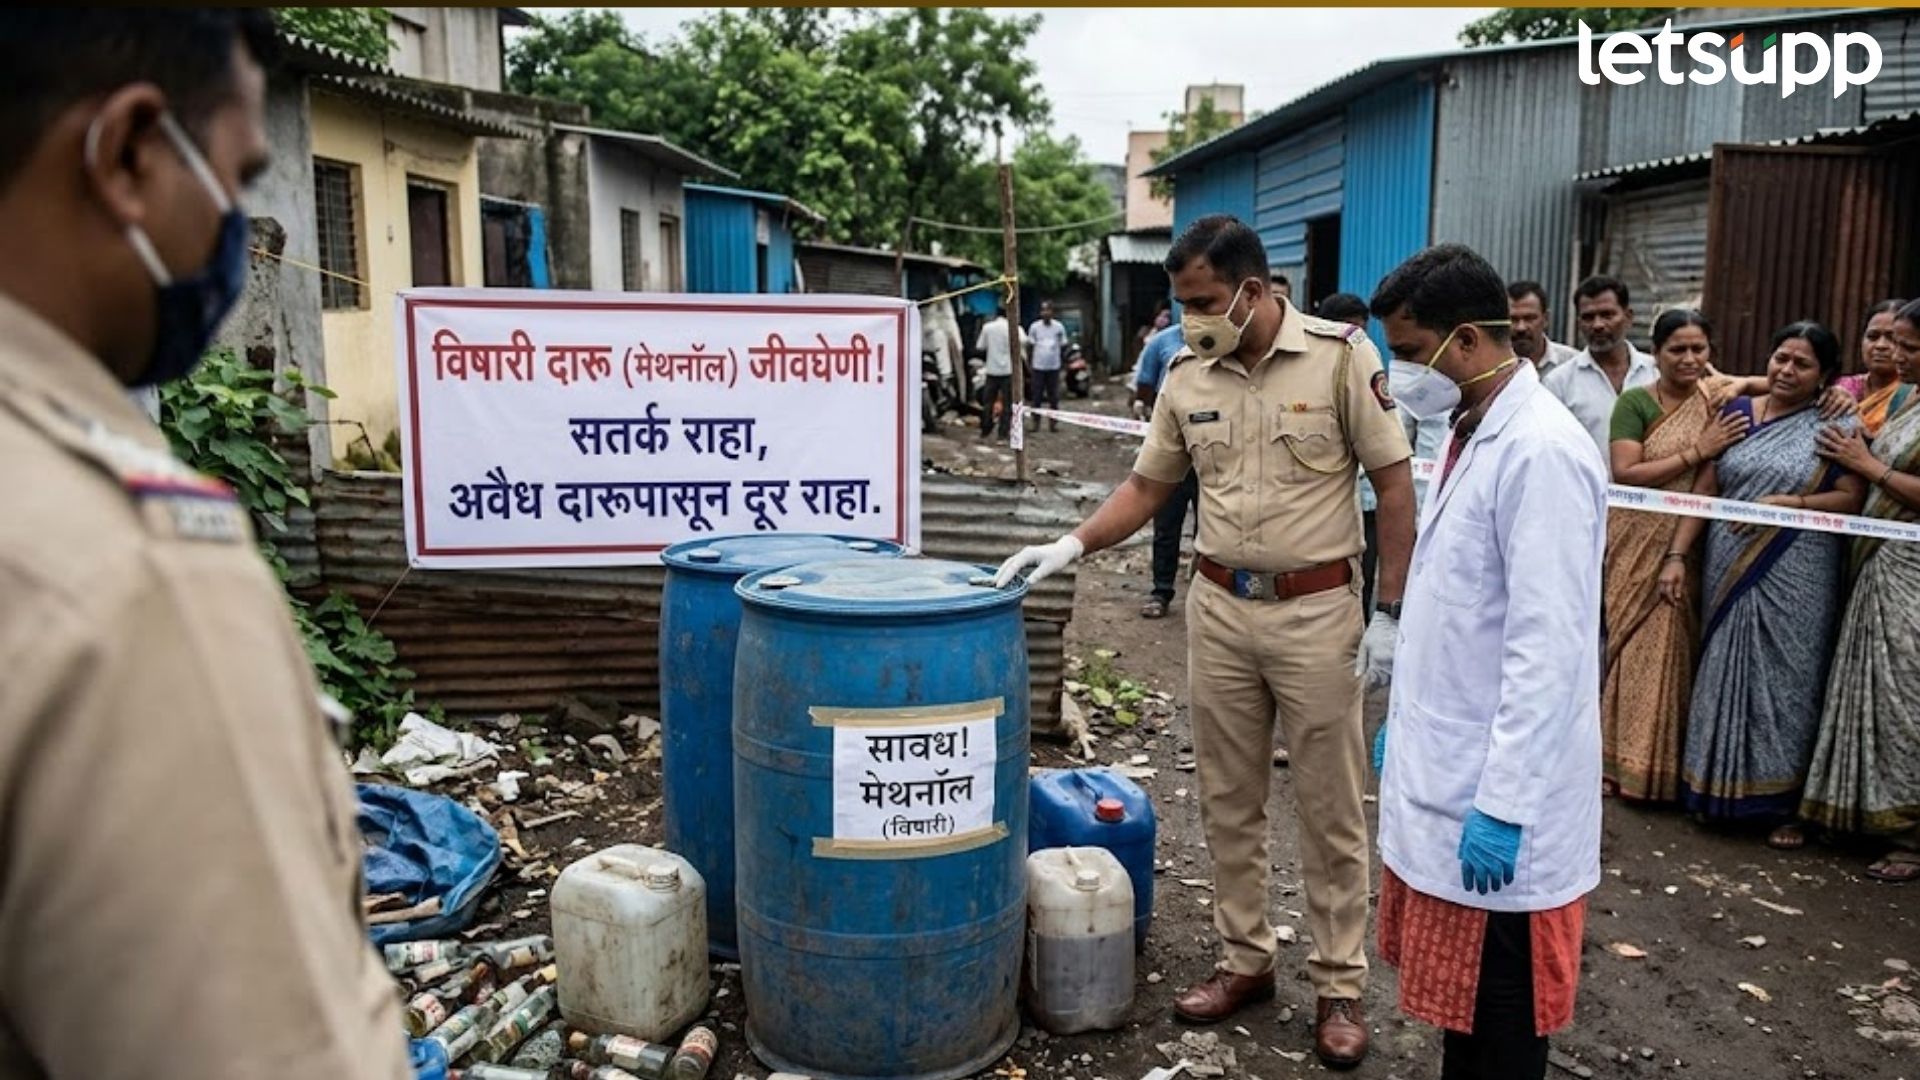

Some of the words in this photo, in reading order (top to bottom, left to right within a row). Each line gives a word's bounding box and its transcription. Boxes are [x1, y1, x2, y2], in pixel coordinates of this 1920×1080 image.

[432, 329, 535, 382] विषारी
[546, 345, 611, 386] दारू
[622, 342, 738, 389] (मेथनॉल)
[748, 332, 886, 383] जीवघेणी!
[569, 403, 670, 455] सतर्क
[683, 418, 768, 461] राहा,
[449, 466, 543, 521] अवैध
[556, 482, 731, 530] दारूपासून
[743, 480, 790, 531] दूर
[801, 480, 881, 520] राहा.
[865, 726, 968, 763] सावध!
[859, 768, 974, 809] मेथनॉल
